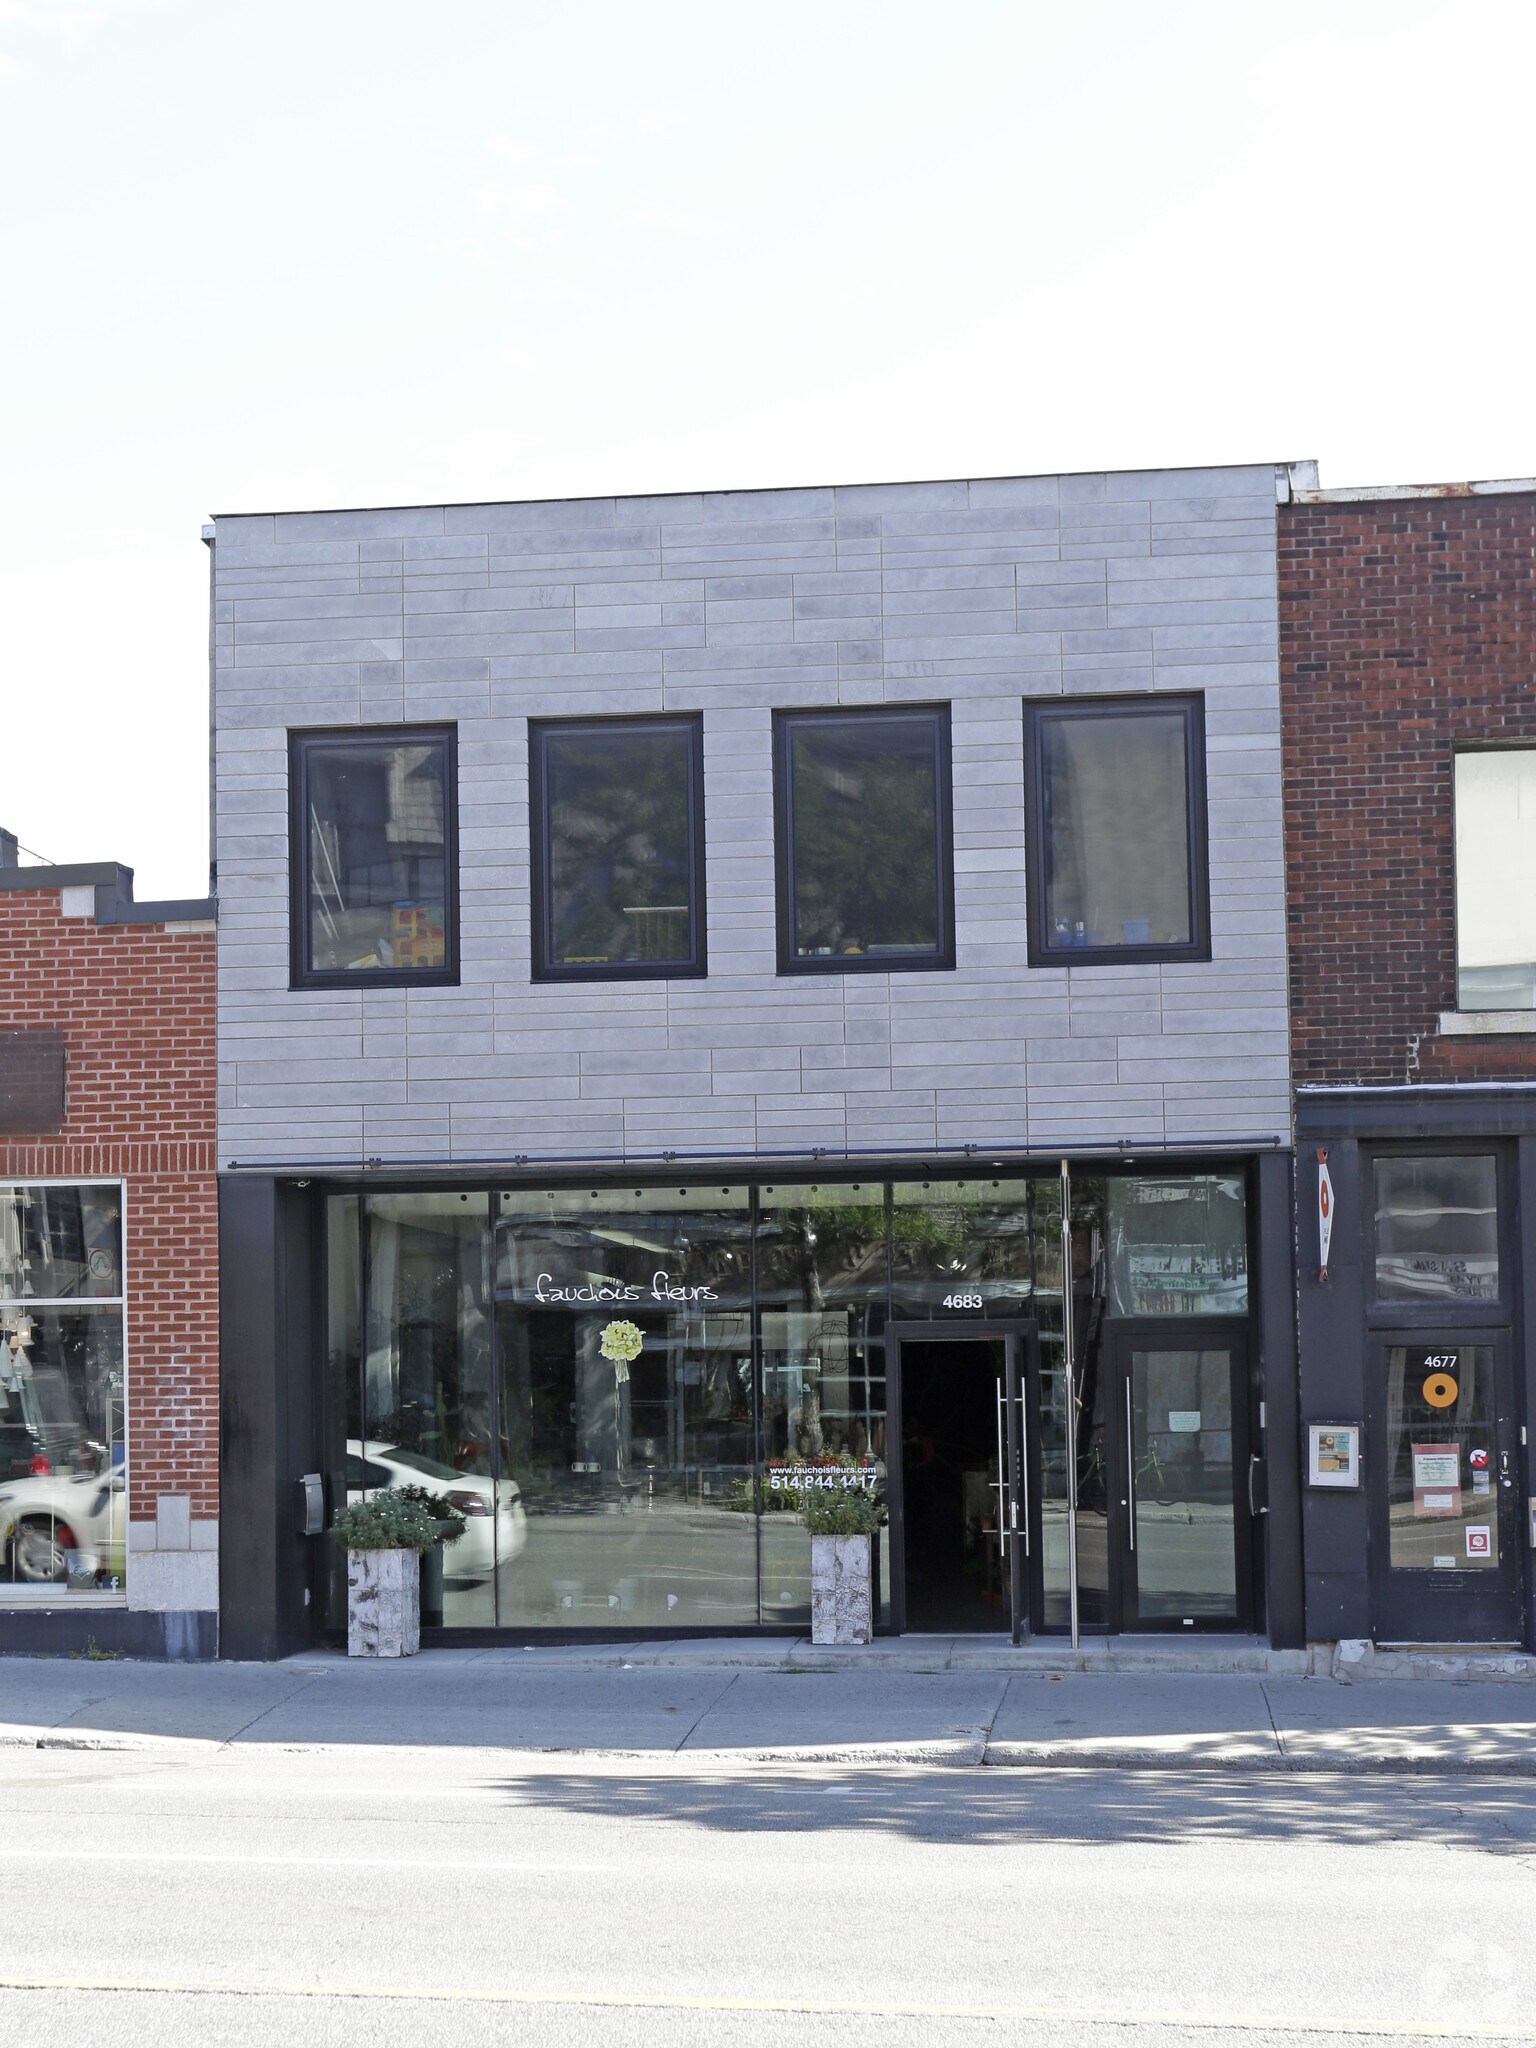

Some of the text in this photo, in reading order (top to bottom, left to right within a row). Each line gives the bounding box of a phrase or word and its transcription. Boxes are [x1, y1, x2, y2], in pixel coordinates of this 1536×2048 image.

[534, 1270, 719, 1303] fauchois fleurs
[942, 1294, 983, 1309] 4683
[1424, 1355, 1457, 1368] 4677
[769, 1466, 876, 1474] www.fauchoisfleurs.com
